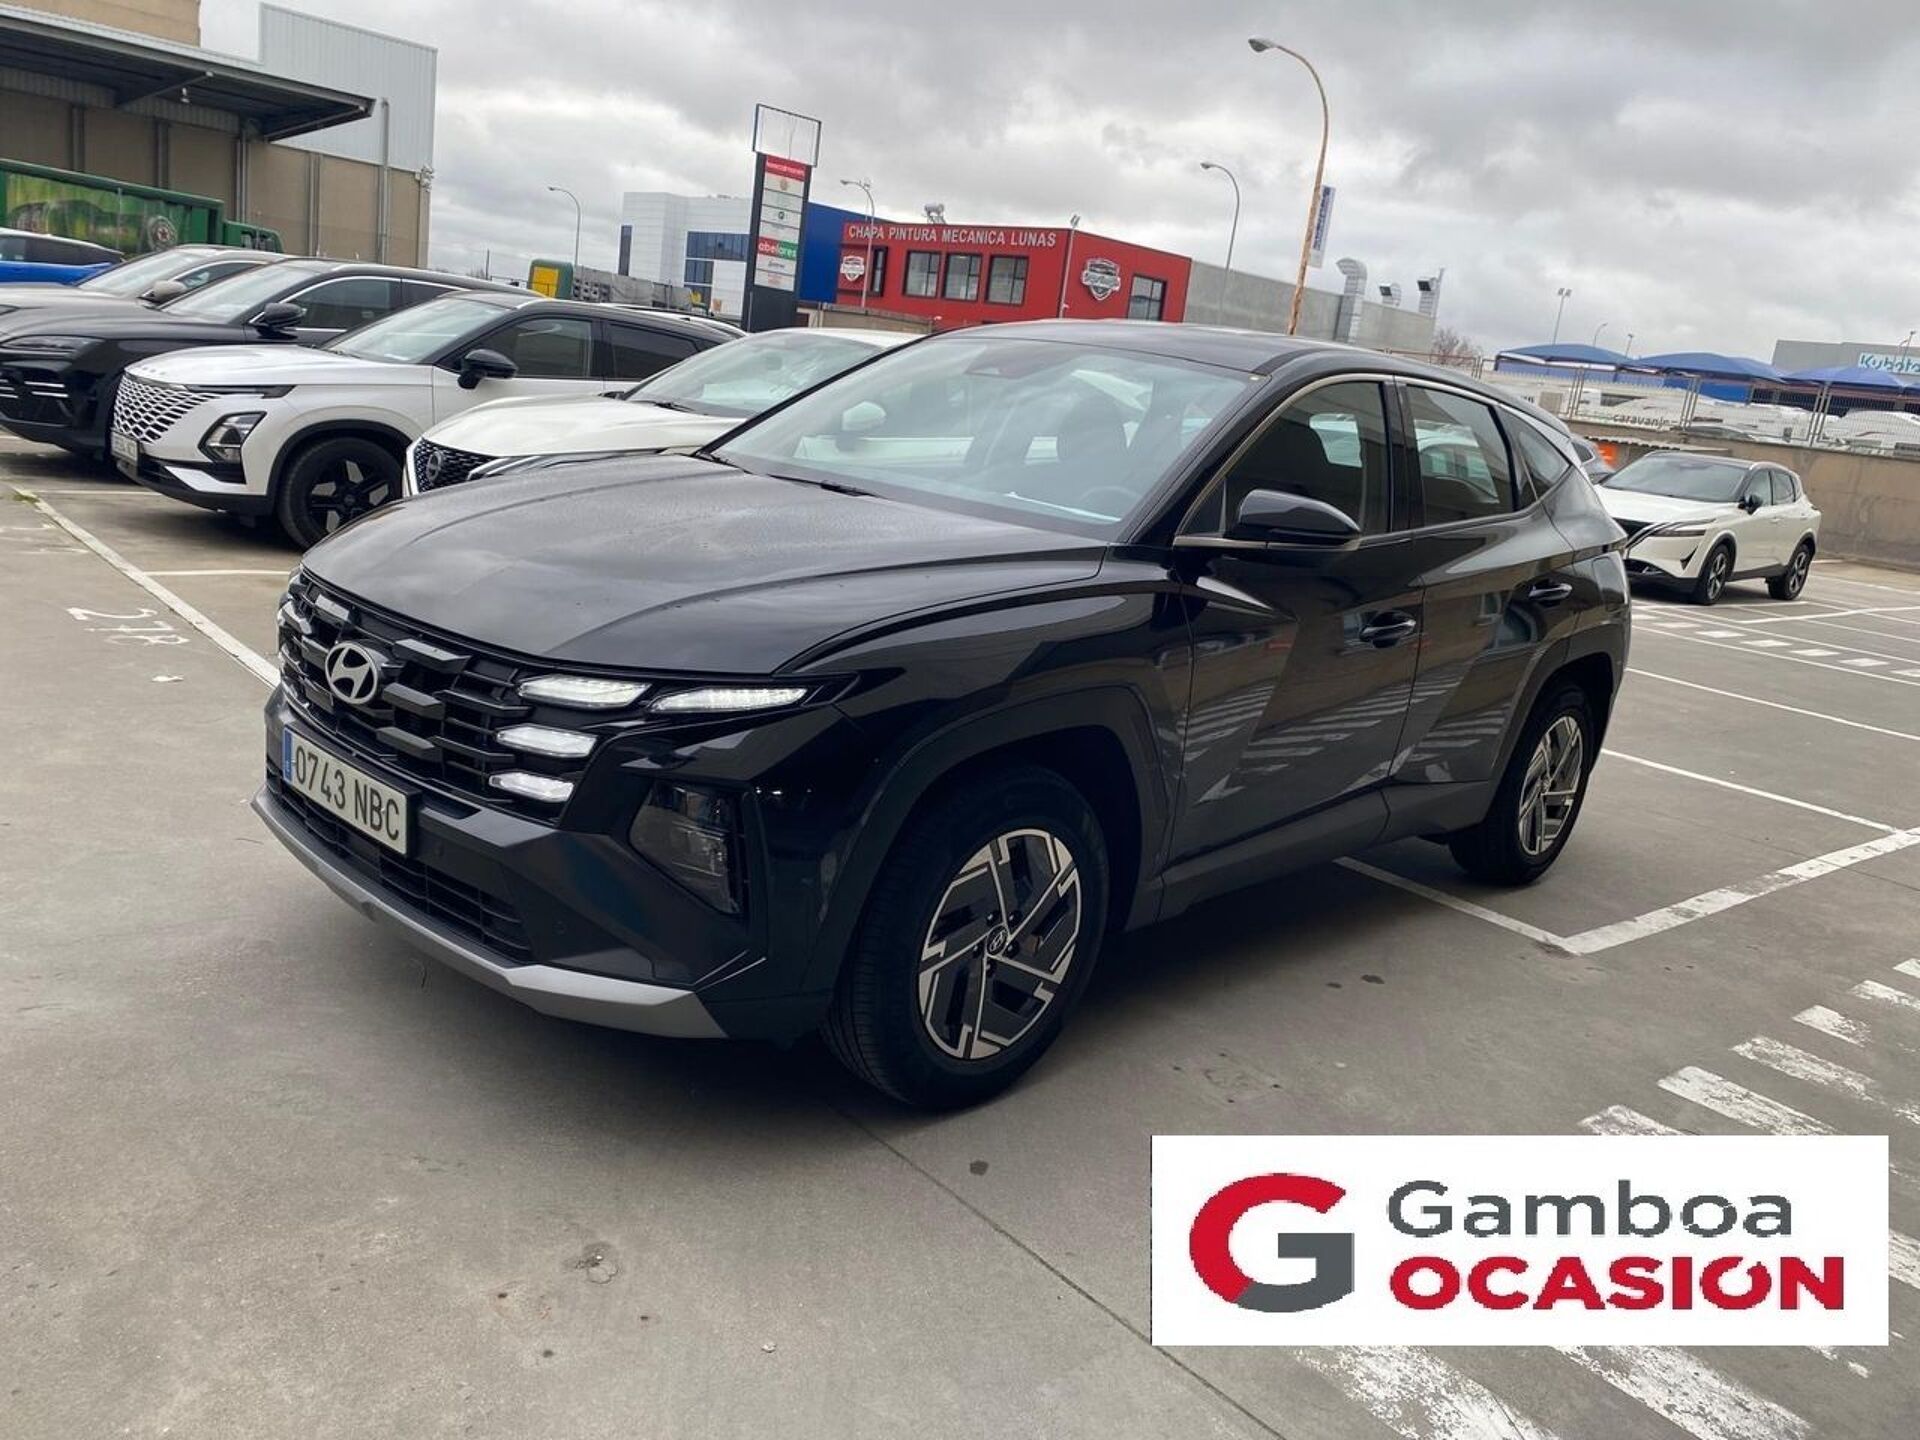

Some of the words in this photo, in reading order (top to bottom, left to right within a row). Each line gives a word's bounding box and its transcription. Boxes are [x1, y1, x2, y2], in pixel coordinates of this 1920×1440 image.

[848, 225, 884, 239] CHAPA
[889, 226, 937, 241] PINTURA
[942, 229, 1006, 244] MECANICA
[1010, 231, 1057, 247] LUNAS
[295, 745, 346, 810] 0743
[354, 778, 400, 841] NBC
